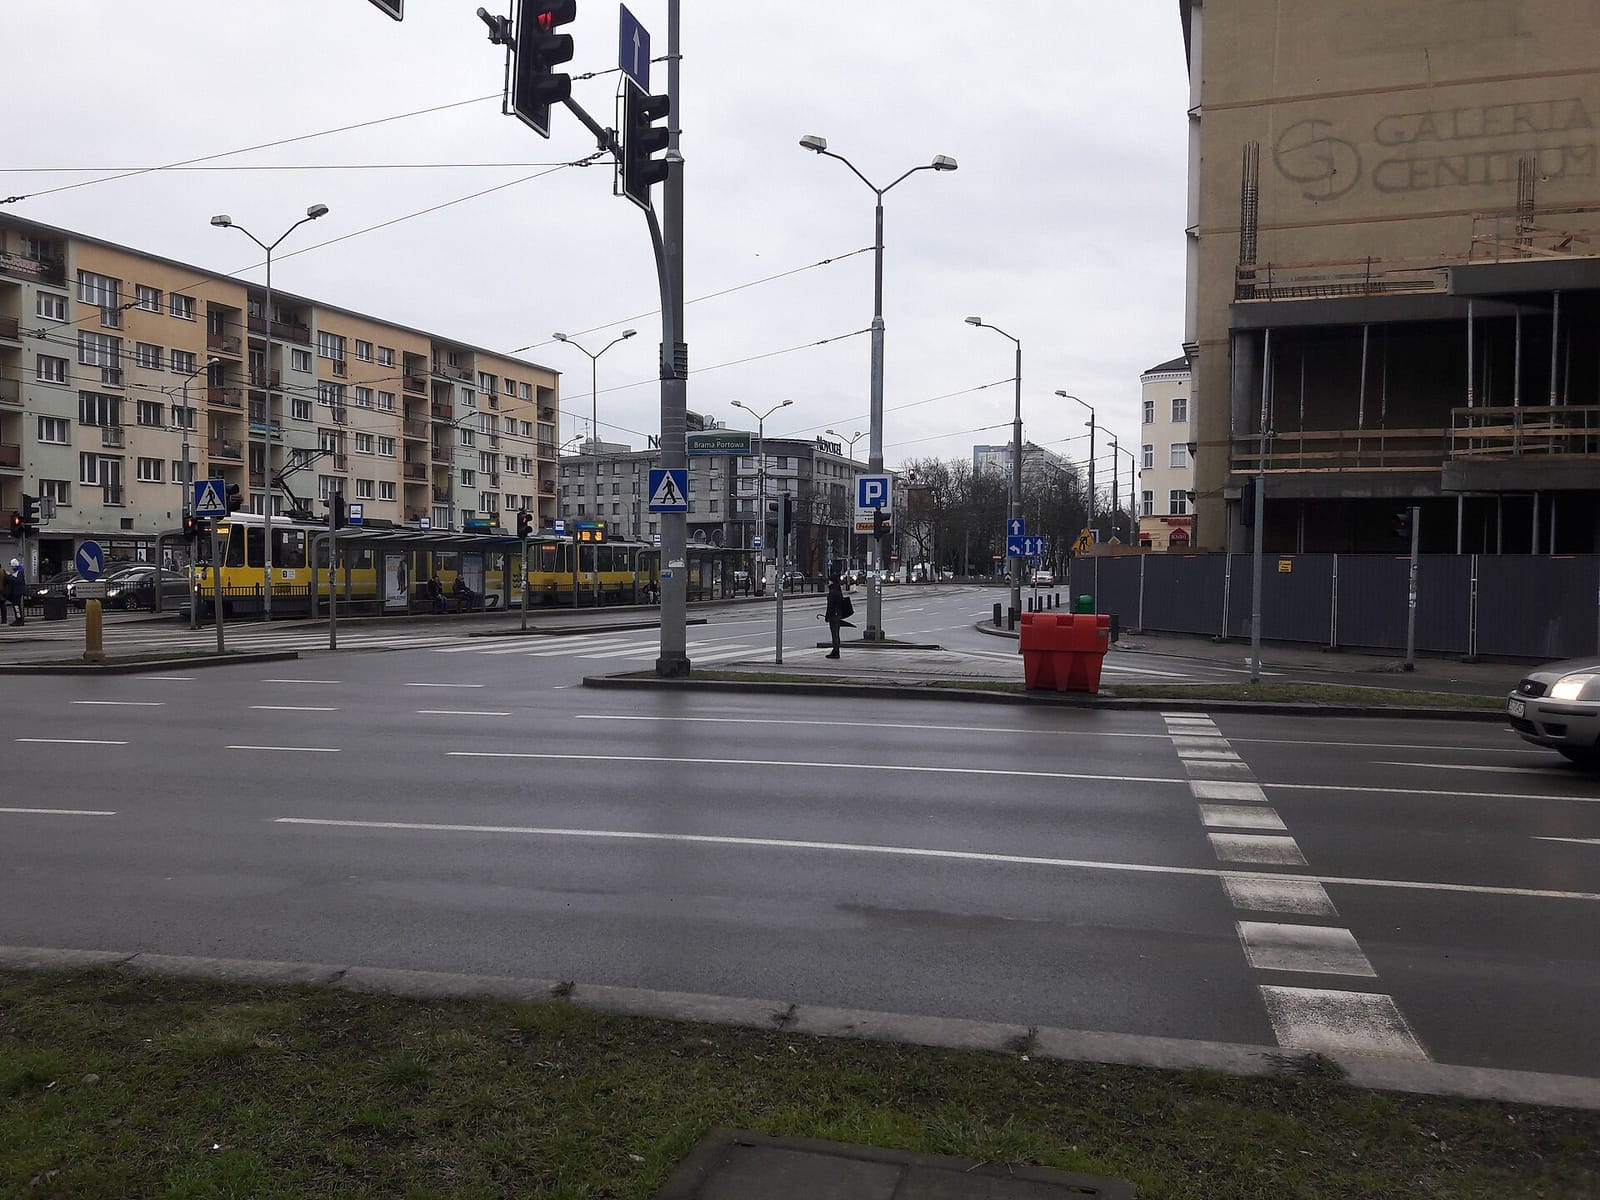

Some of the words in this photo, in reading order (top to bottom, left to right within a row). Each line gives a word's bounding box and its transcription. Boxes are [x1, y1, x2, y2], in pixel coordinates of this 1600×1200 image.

[1374, 97, 1594, 146] GALERIA
[694, 441, 715, 449] Brama
[866, 482, 882, 505] P
